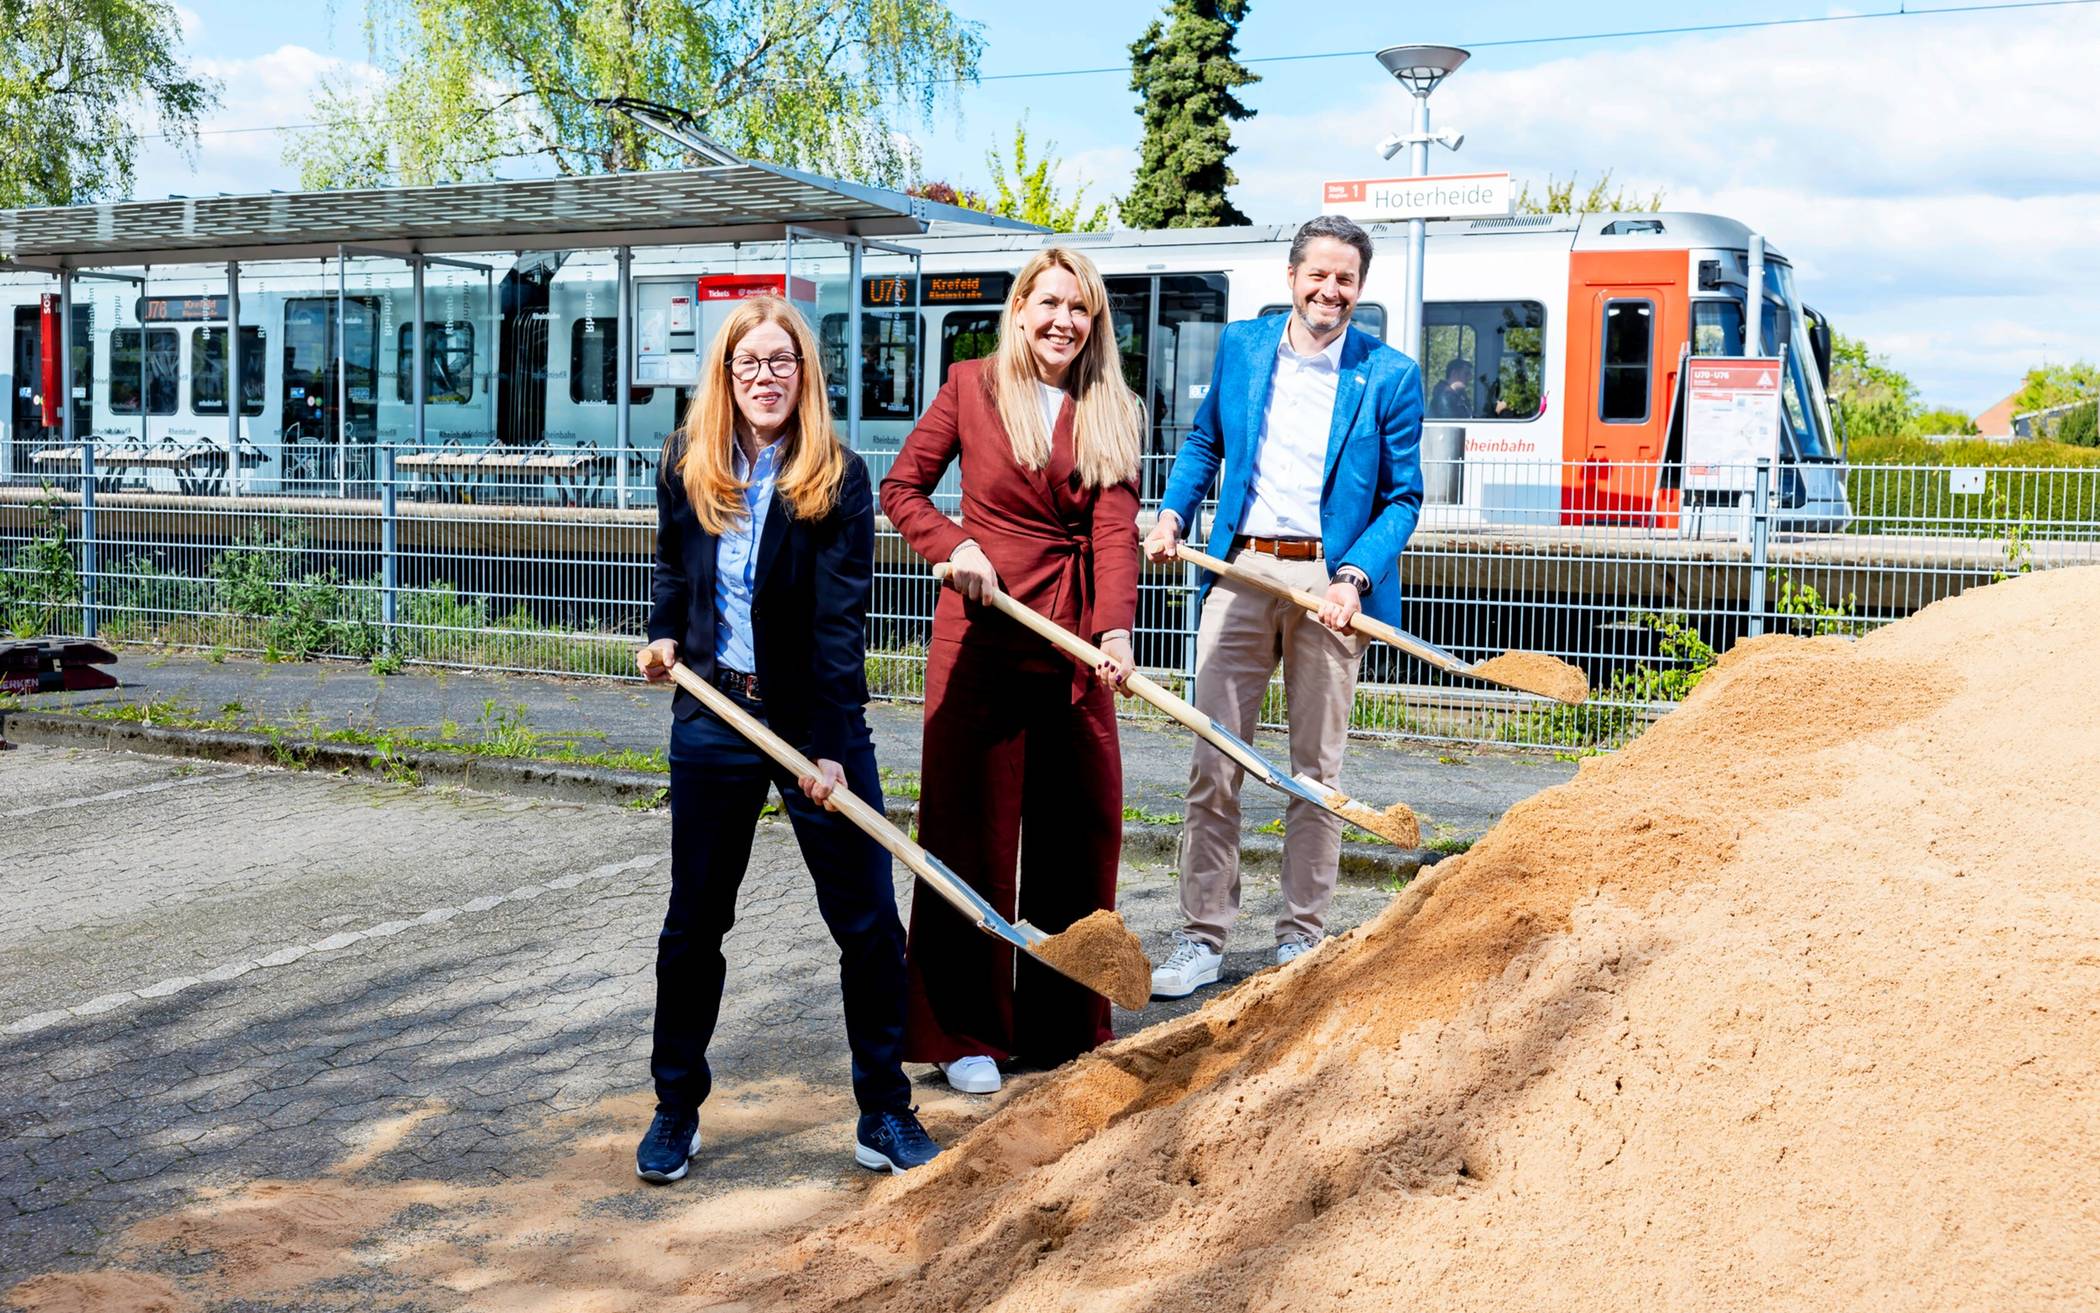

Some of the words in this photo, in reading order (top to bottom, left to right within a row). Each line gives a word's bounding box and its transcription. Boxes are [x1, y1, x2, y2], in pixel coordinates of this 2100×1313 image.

[1352, 185, 1358, 198] 1
[1376, 184, 1493, 209] Hoterheide
[870, 279, 908, 302] U76
[932, 278, 980, 290] Krefeld
[43, 292, 51, 314] SOS
[1465, 438, 1535, 452] Rheinbahn
[0, 678, 38, 689] ERKEN
